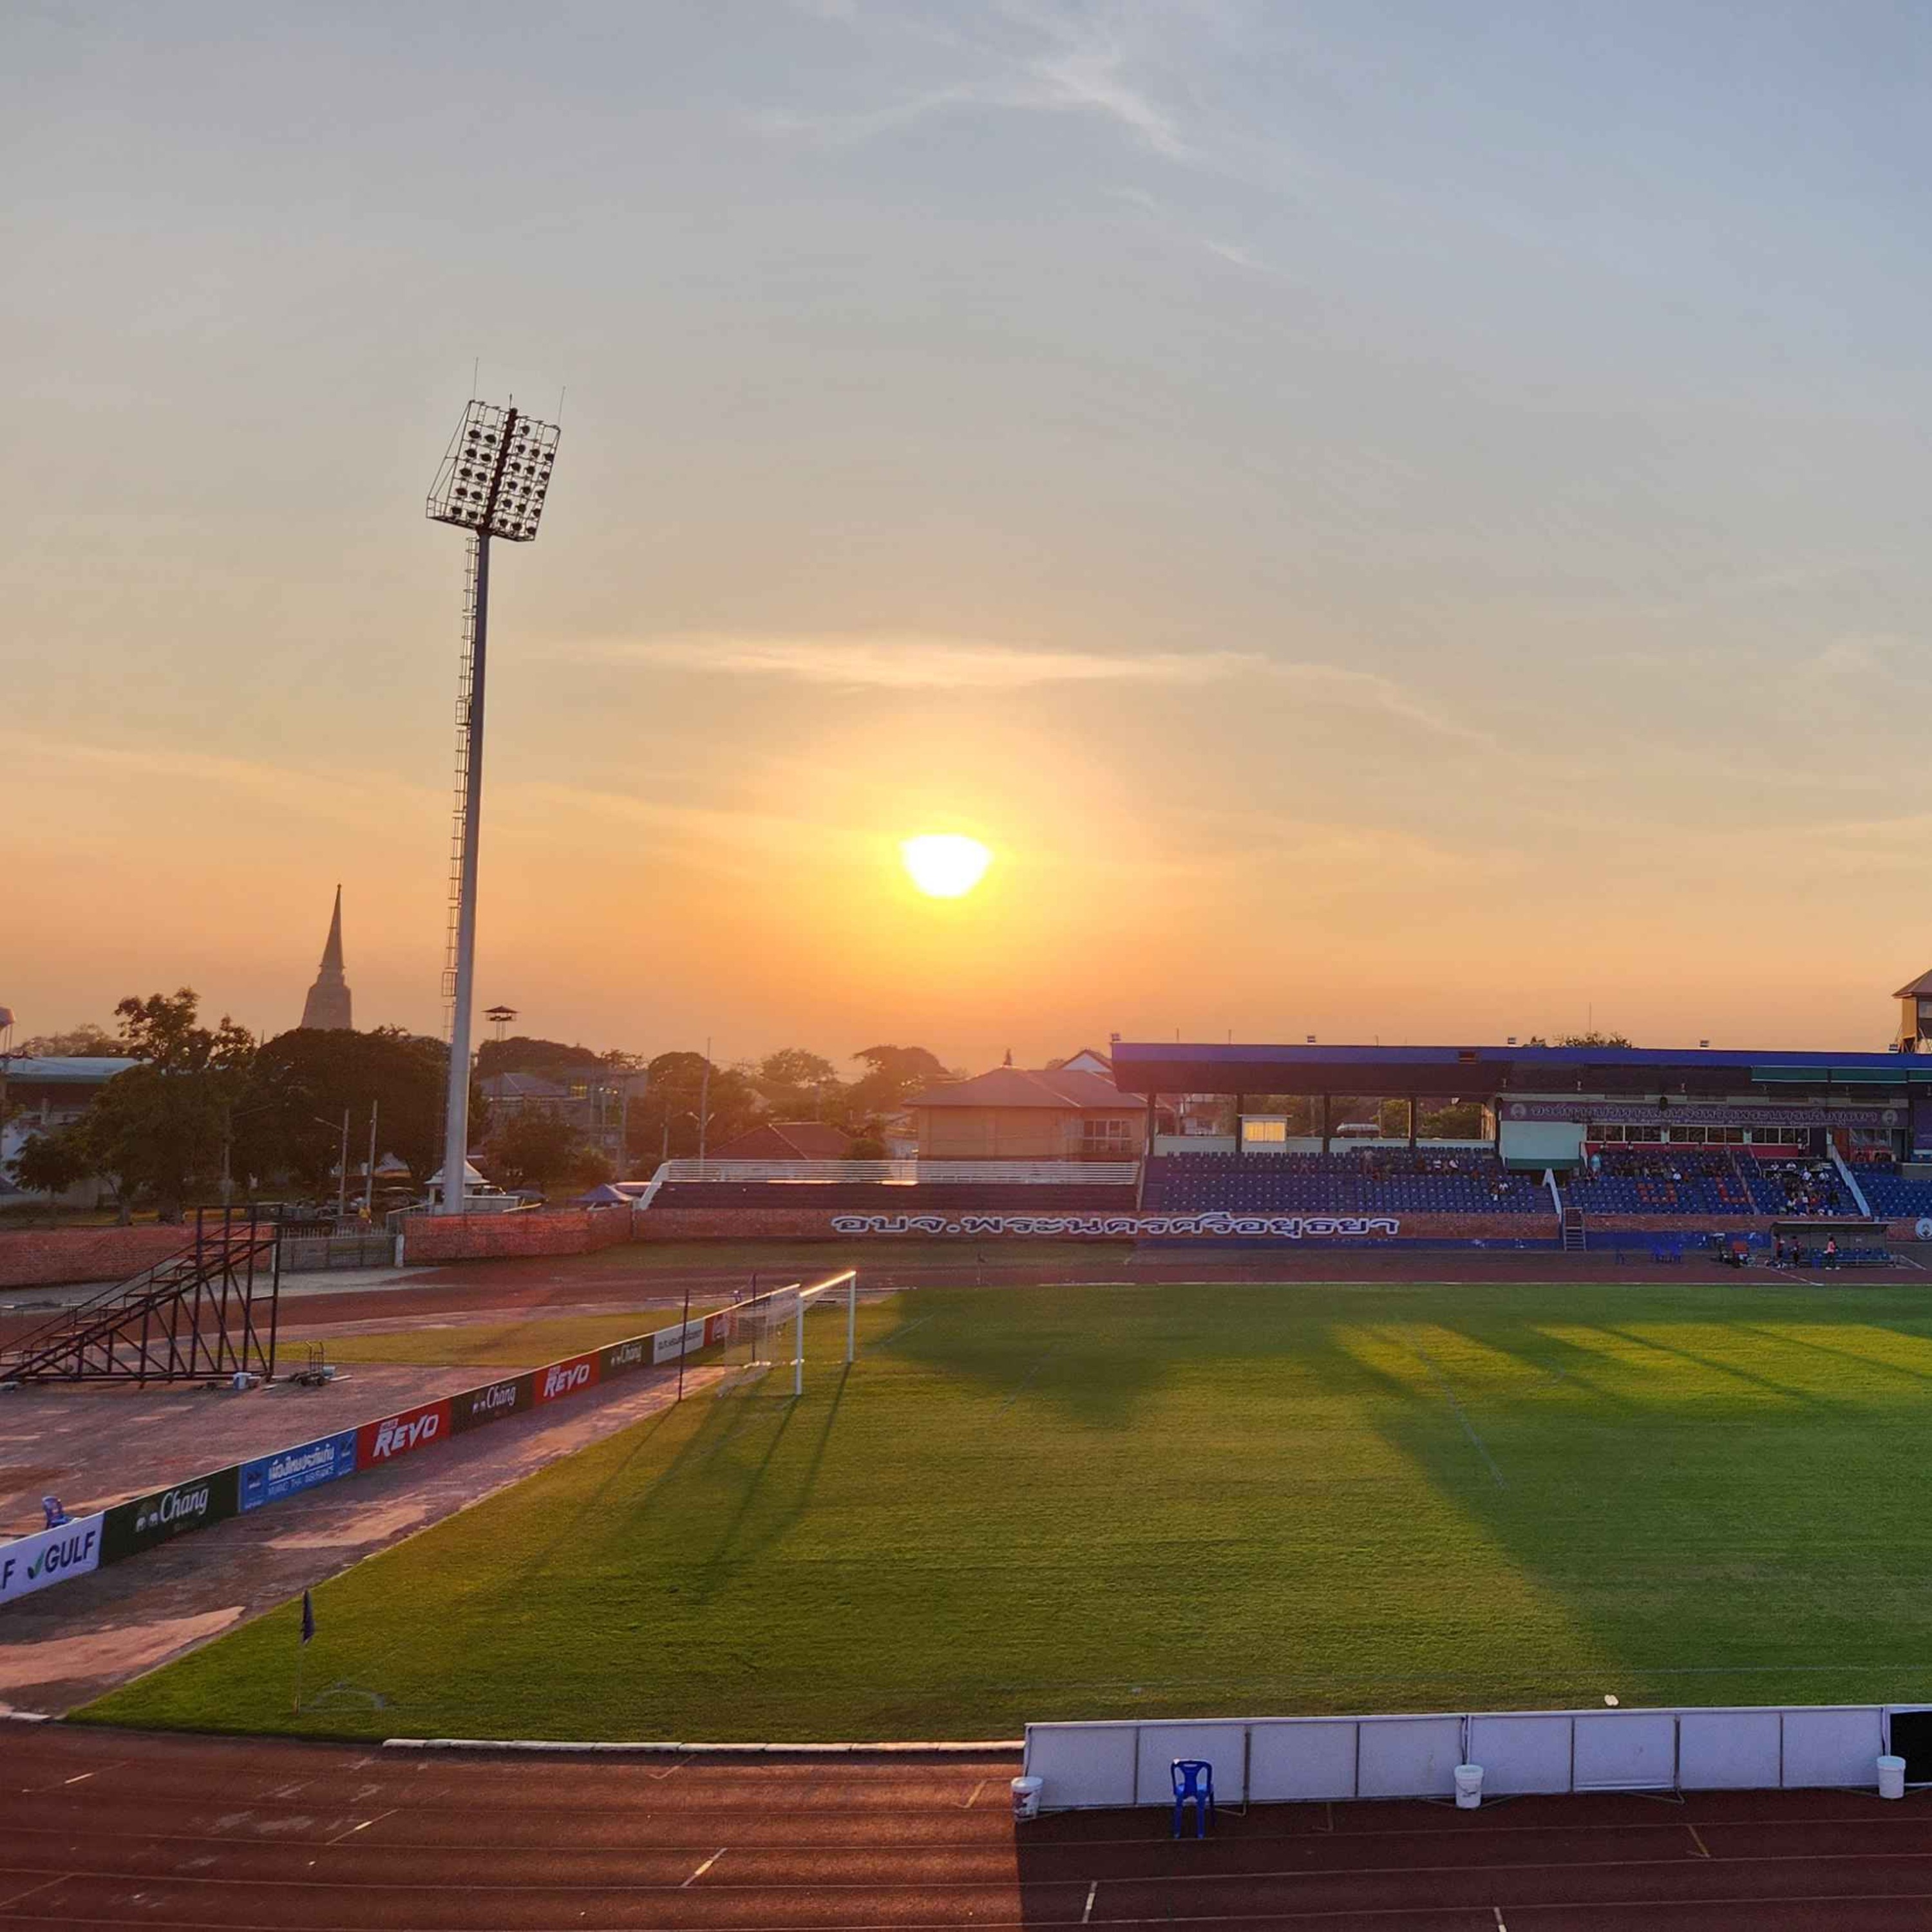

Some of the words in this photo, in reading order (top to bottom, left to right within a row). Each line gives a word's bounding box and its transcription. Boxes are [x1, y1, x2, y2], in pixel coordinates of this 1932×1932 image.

[831, 1211, 1400, 1238] อบจ.พระนครศรีอยุธยา
[620, 1341, 643, 1363] Chang
[486, 1385, 516, 1408] Chang
[543, 1363, 591, 1399] REVO
[372, 1414, 439, 1457] REVO
[161, 1488, 209, 1522] Chang
[45, 1530, 95, 1573] GULF
